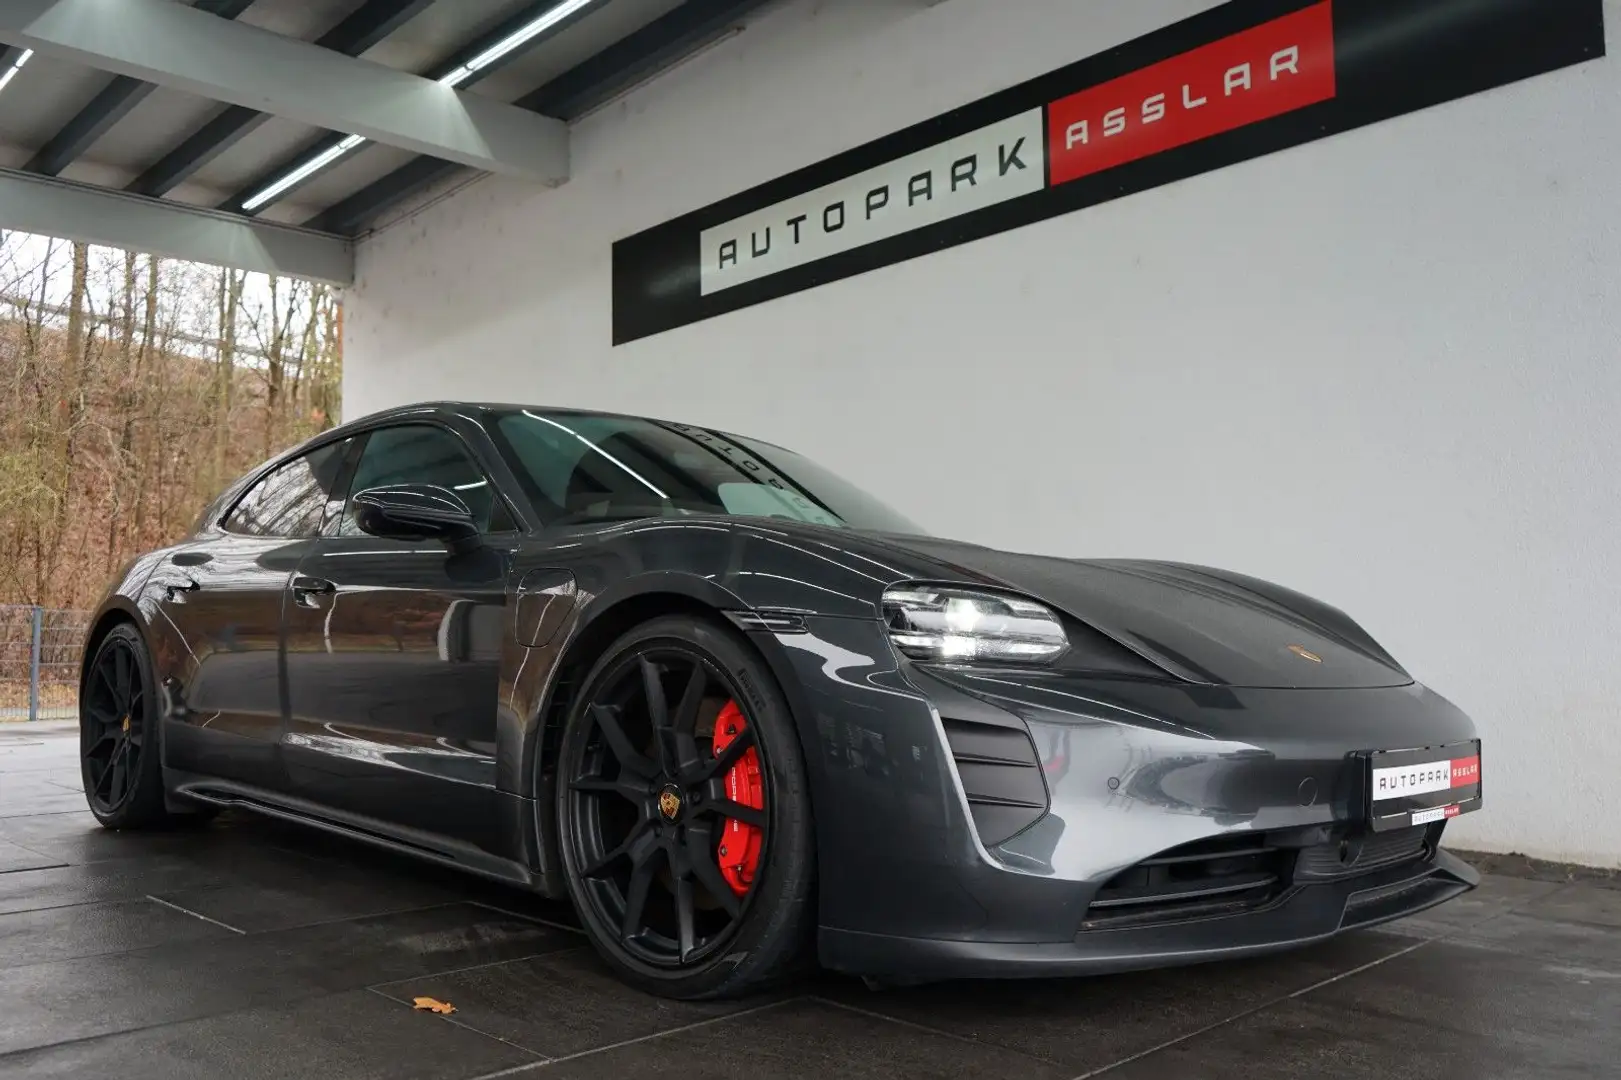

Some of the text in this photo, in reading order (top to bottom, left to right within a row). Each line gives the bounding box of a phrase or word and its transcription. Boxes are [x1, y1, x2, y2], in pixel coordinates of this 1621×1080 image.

[719, 45, 1299, 269] AUTOPARK ASSLAR
[1380, 769, 1448, 790] AUTOPARK
